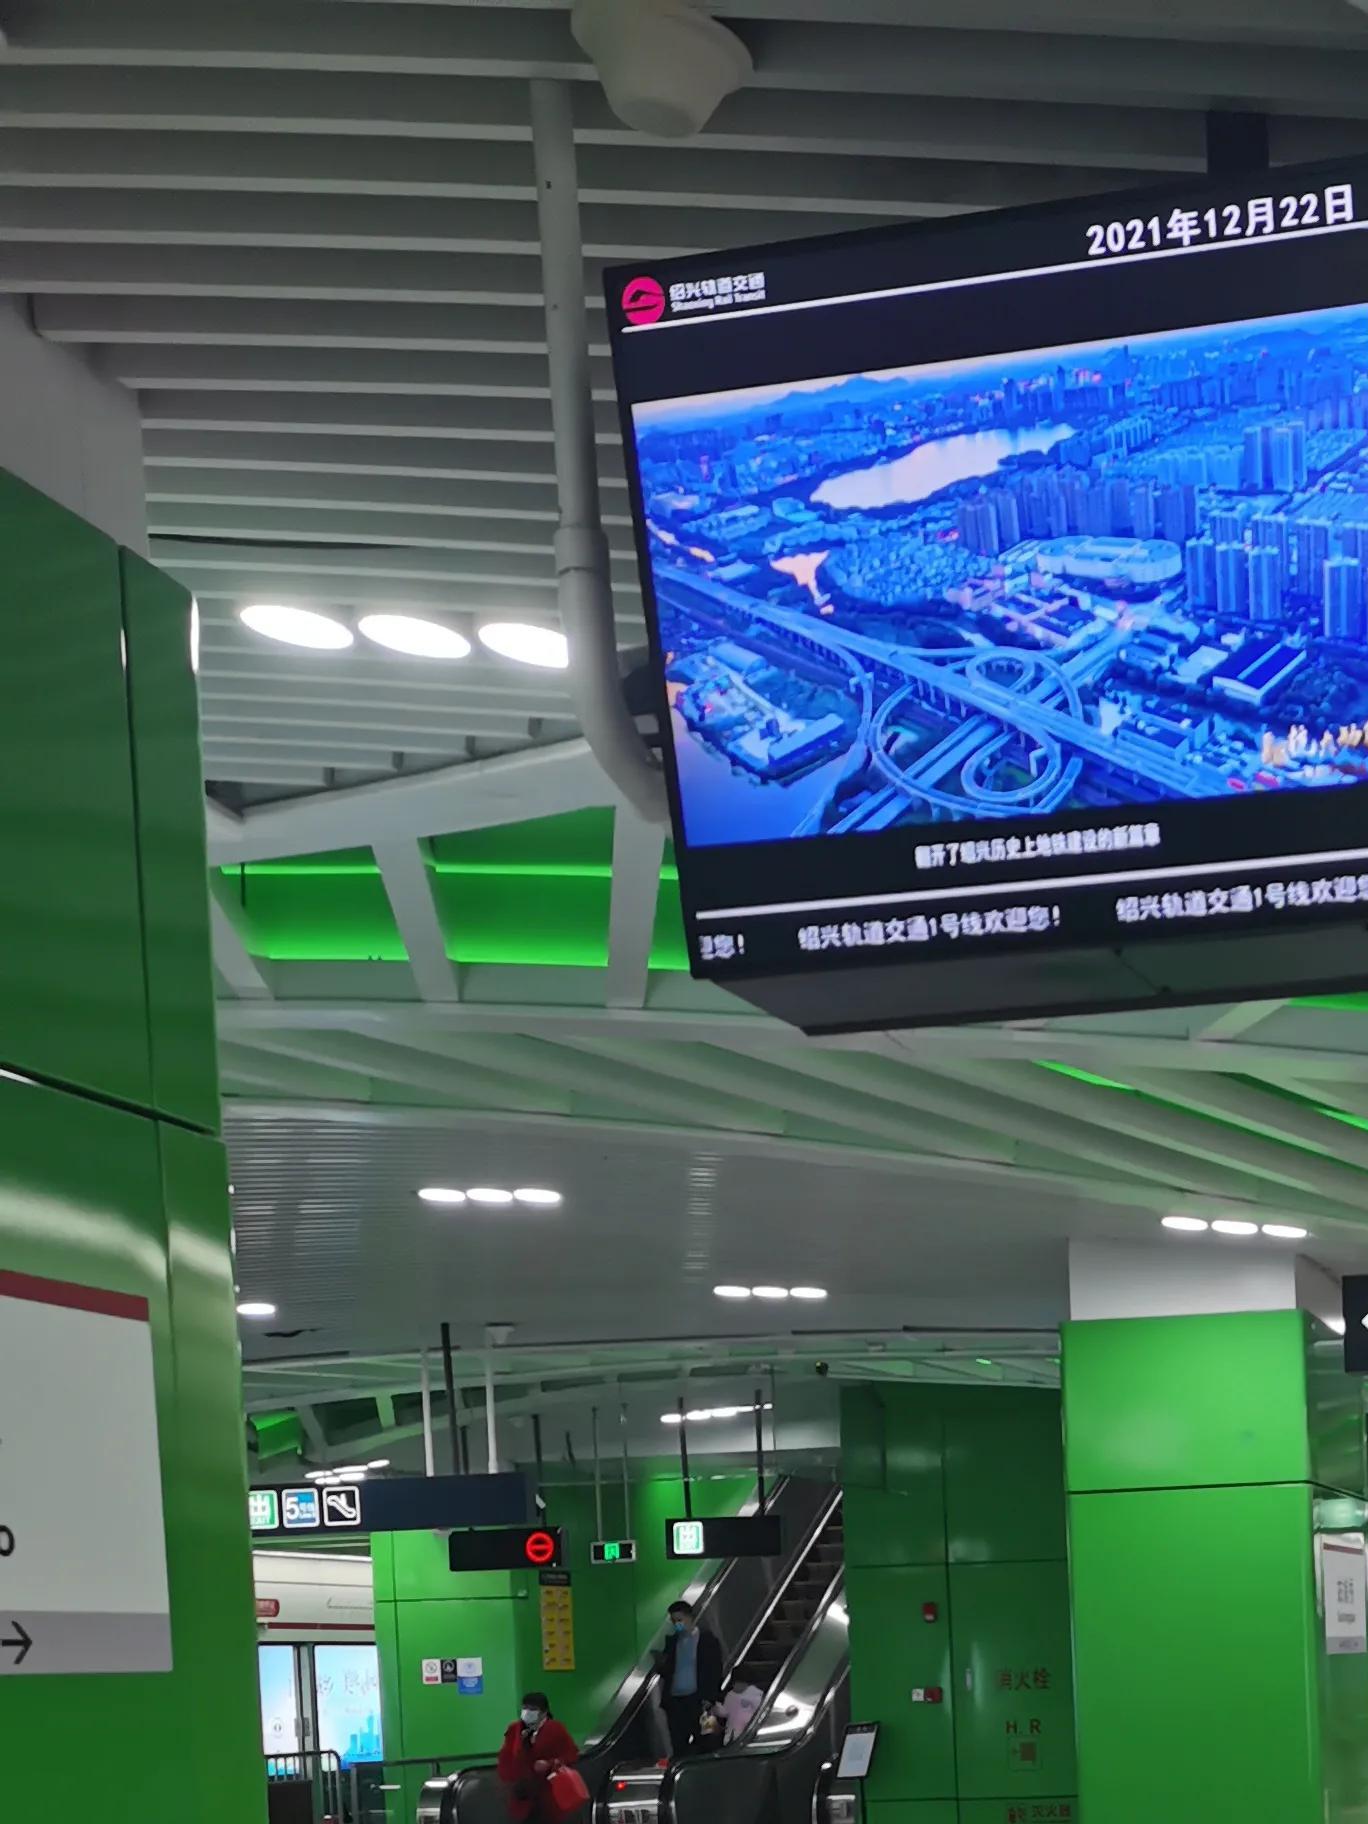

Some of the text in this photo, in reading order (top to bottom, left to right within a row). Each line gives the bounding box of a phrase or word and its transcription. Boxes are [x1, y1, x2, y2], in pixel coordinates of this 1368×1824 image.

[1086, 184, 1353, 255] 2021年12月22日
[669, 272, 765, 300] 绍兴轨道交通
[286, 1496, 300, 1520] 5
